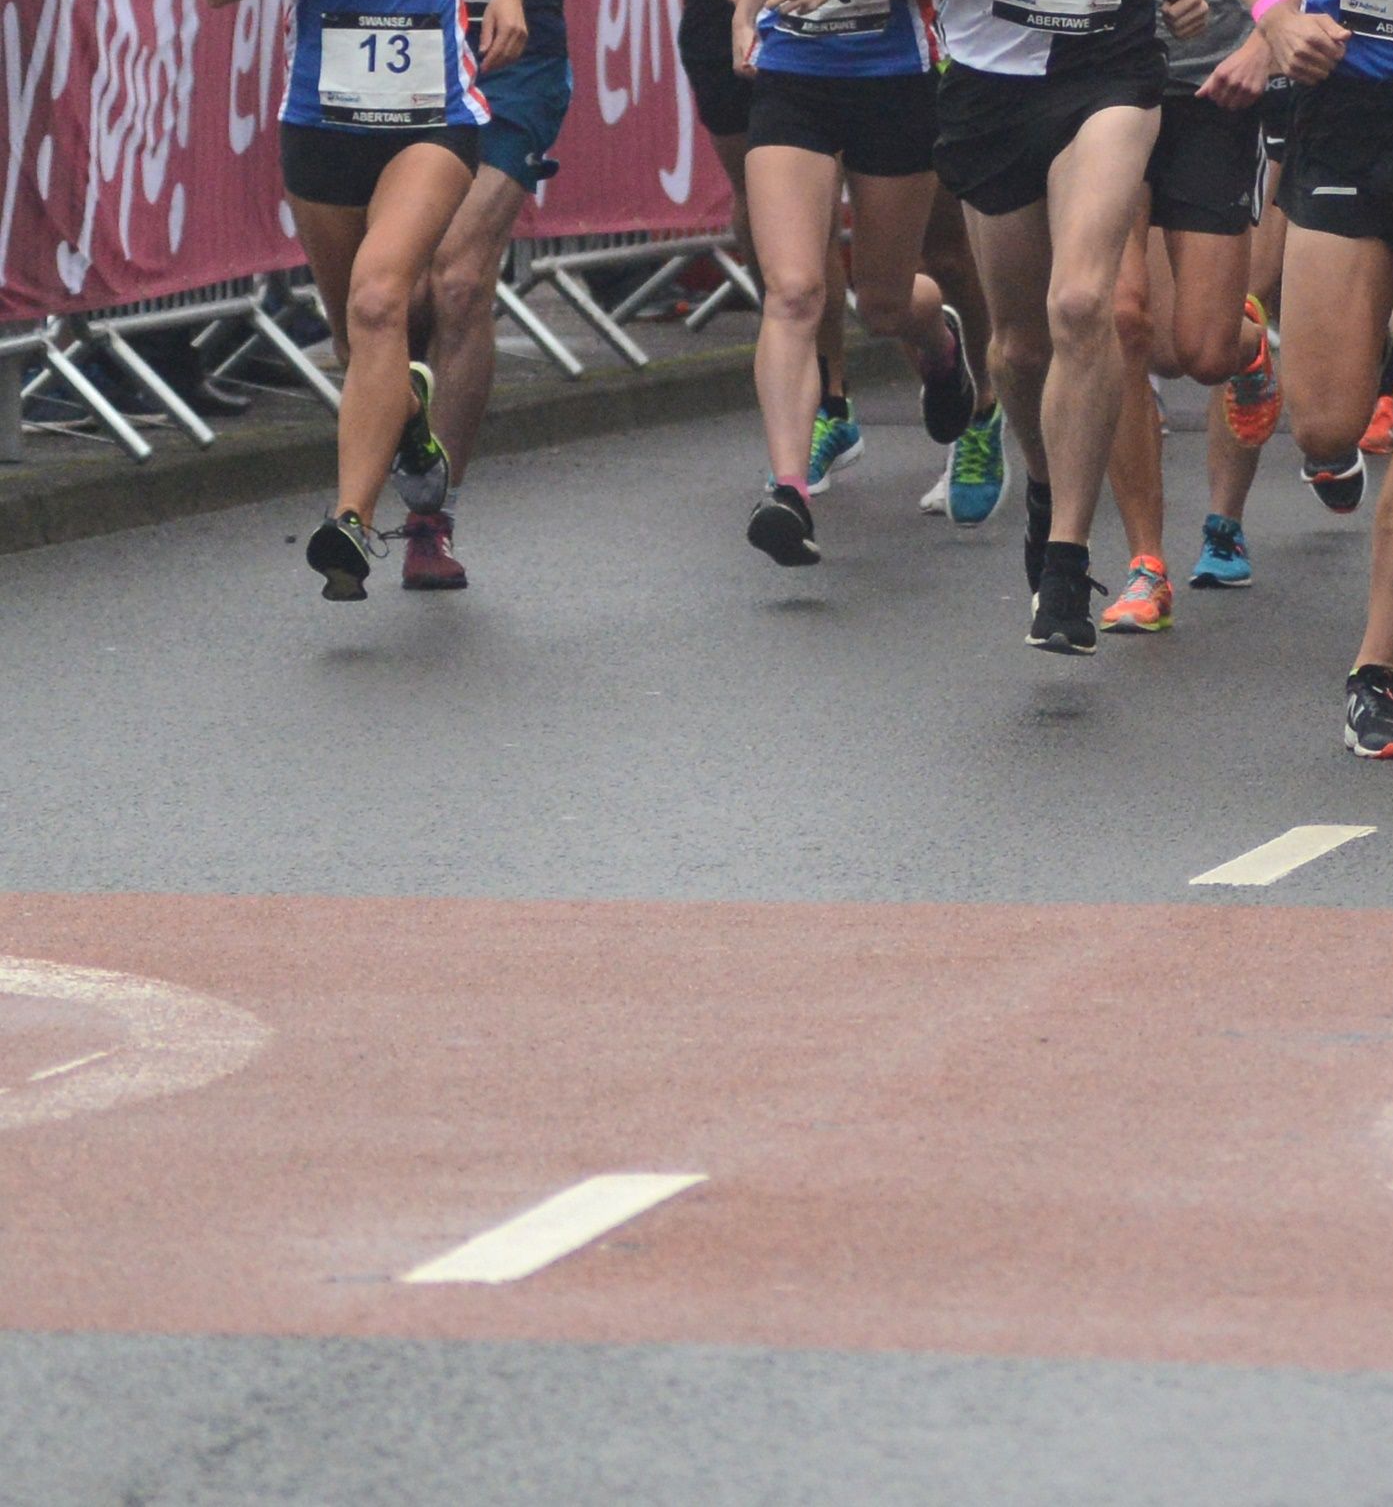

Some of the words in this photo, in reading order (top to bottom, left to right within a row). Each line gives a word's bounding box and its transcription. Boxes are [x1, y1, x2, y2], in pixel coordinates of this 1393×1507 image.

[358, 16, 414, 28] SWANSEA
[1026, 12, 1090, 30] ABERTAWE
[359, 33, 412, 74] 13
[351, 111, 412, 124] ABERTAWE
